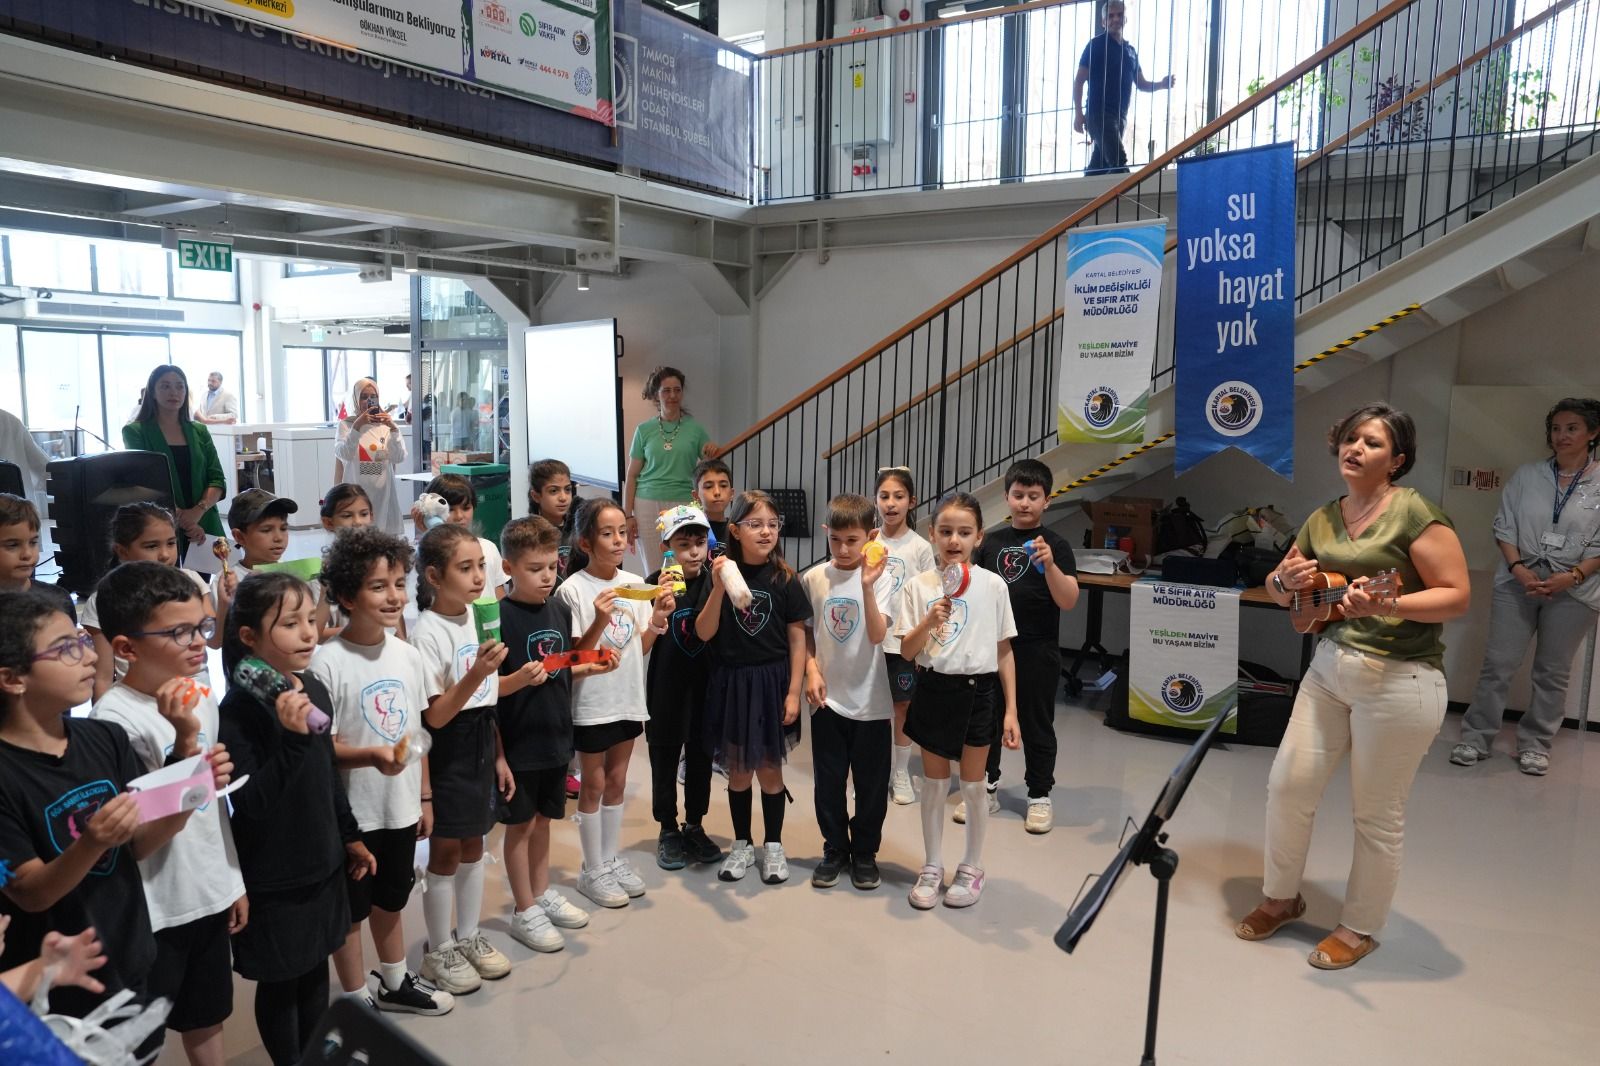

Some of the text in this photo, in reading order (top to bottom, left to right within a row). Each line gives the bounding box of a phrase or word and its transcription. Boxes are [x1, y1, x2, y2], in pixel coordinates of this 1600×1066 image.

[360, 19, 384, 35] GÖKHAN
[385, 26, 407, 41] YÜKSEL
[407, 11, 456, 39] Bekliyoruz
[538, 21, 566, 37] SIFIR ATIK
[538, 30, 556, 41] VAKFI
[642, 46, 675, 68] TMMOB
[641, 64, 677, 85] MAKİNA
[641, 82, 705, 113] MÜHENDİSLERİ
[641, 115, 711, 147] İSTANBUL ŞUBESİ
[1227, 192, 1256, 222] su
[180, 243, 230, 270] EXIT
[1187, 228, 1256, 271] yoksa
[1107, 268, 1142, 278] BELEDİYESİ
[1074, 278, 1151, 294] İKLİM DEĞİŞİKLİĞİ
[1218, 268, 1285, 309] hayat
[1083, 293, 1140, 305] VE SIFIR ATIK
[1083, 303, 1138, 317] MÜDÜRLÜĞÜ
[1216, 311, 1258, 354] yok
[1078, 339, 1138, 351] YEŞİLDEN MAVİYE
[1089, 351, 1114, 360] YAŞAM
[1114, 349, 1134, 358] BİZİM
[1211, 386, 1257, 409] KARTAL BELEDİYESİ
[1153, 584, 1166, 595] VE
[1168, 586, 1192, 597] SIFIR
[1194, 590, 1217, 599] ATIK
[1152, 595, 1216, 610] MÜDÜRLÜĞÜ
[1149, 628, 1219, 641] YEŞİLDEN MAVİYE
[1152, 637, 1216, 649] BU YAŞAM BİZİM
